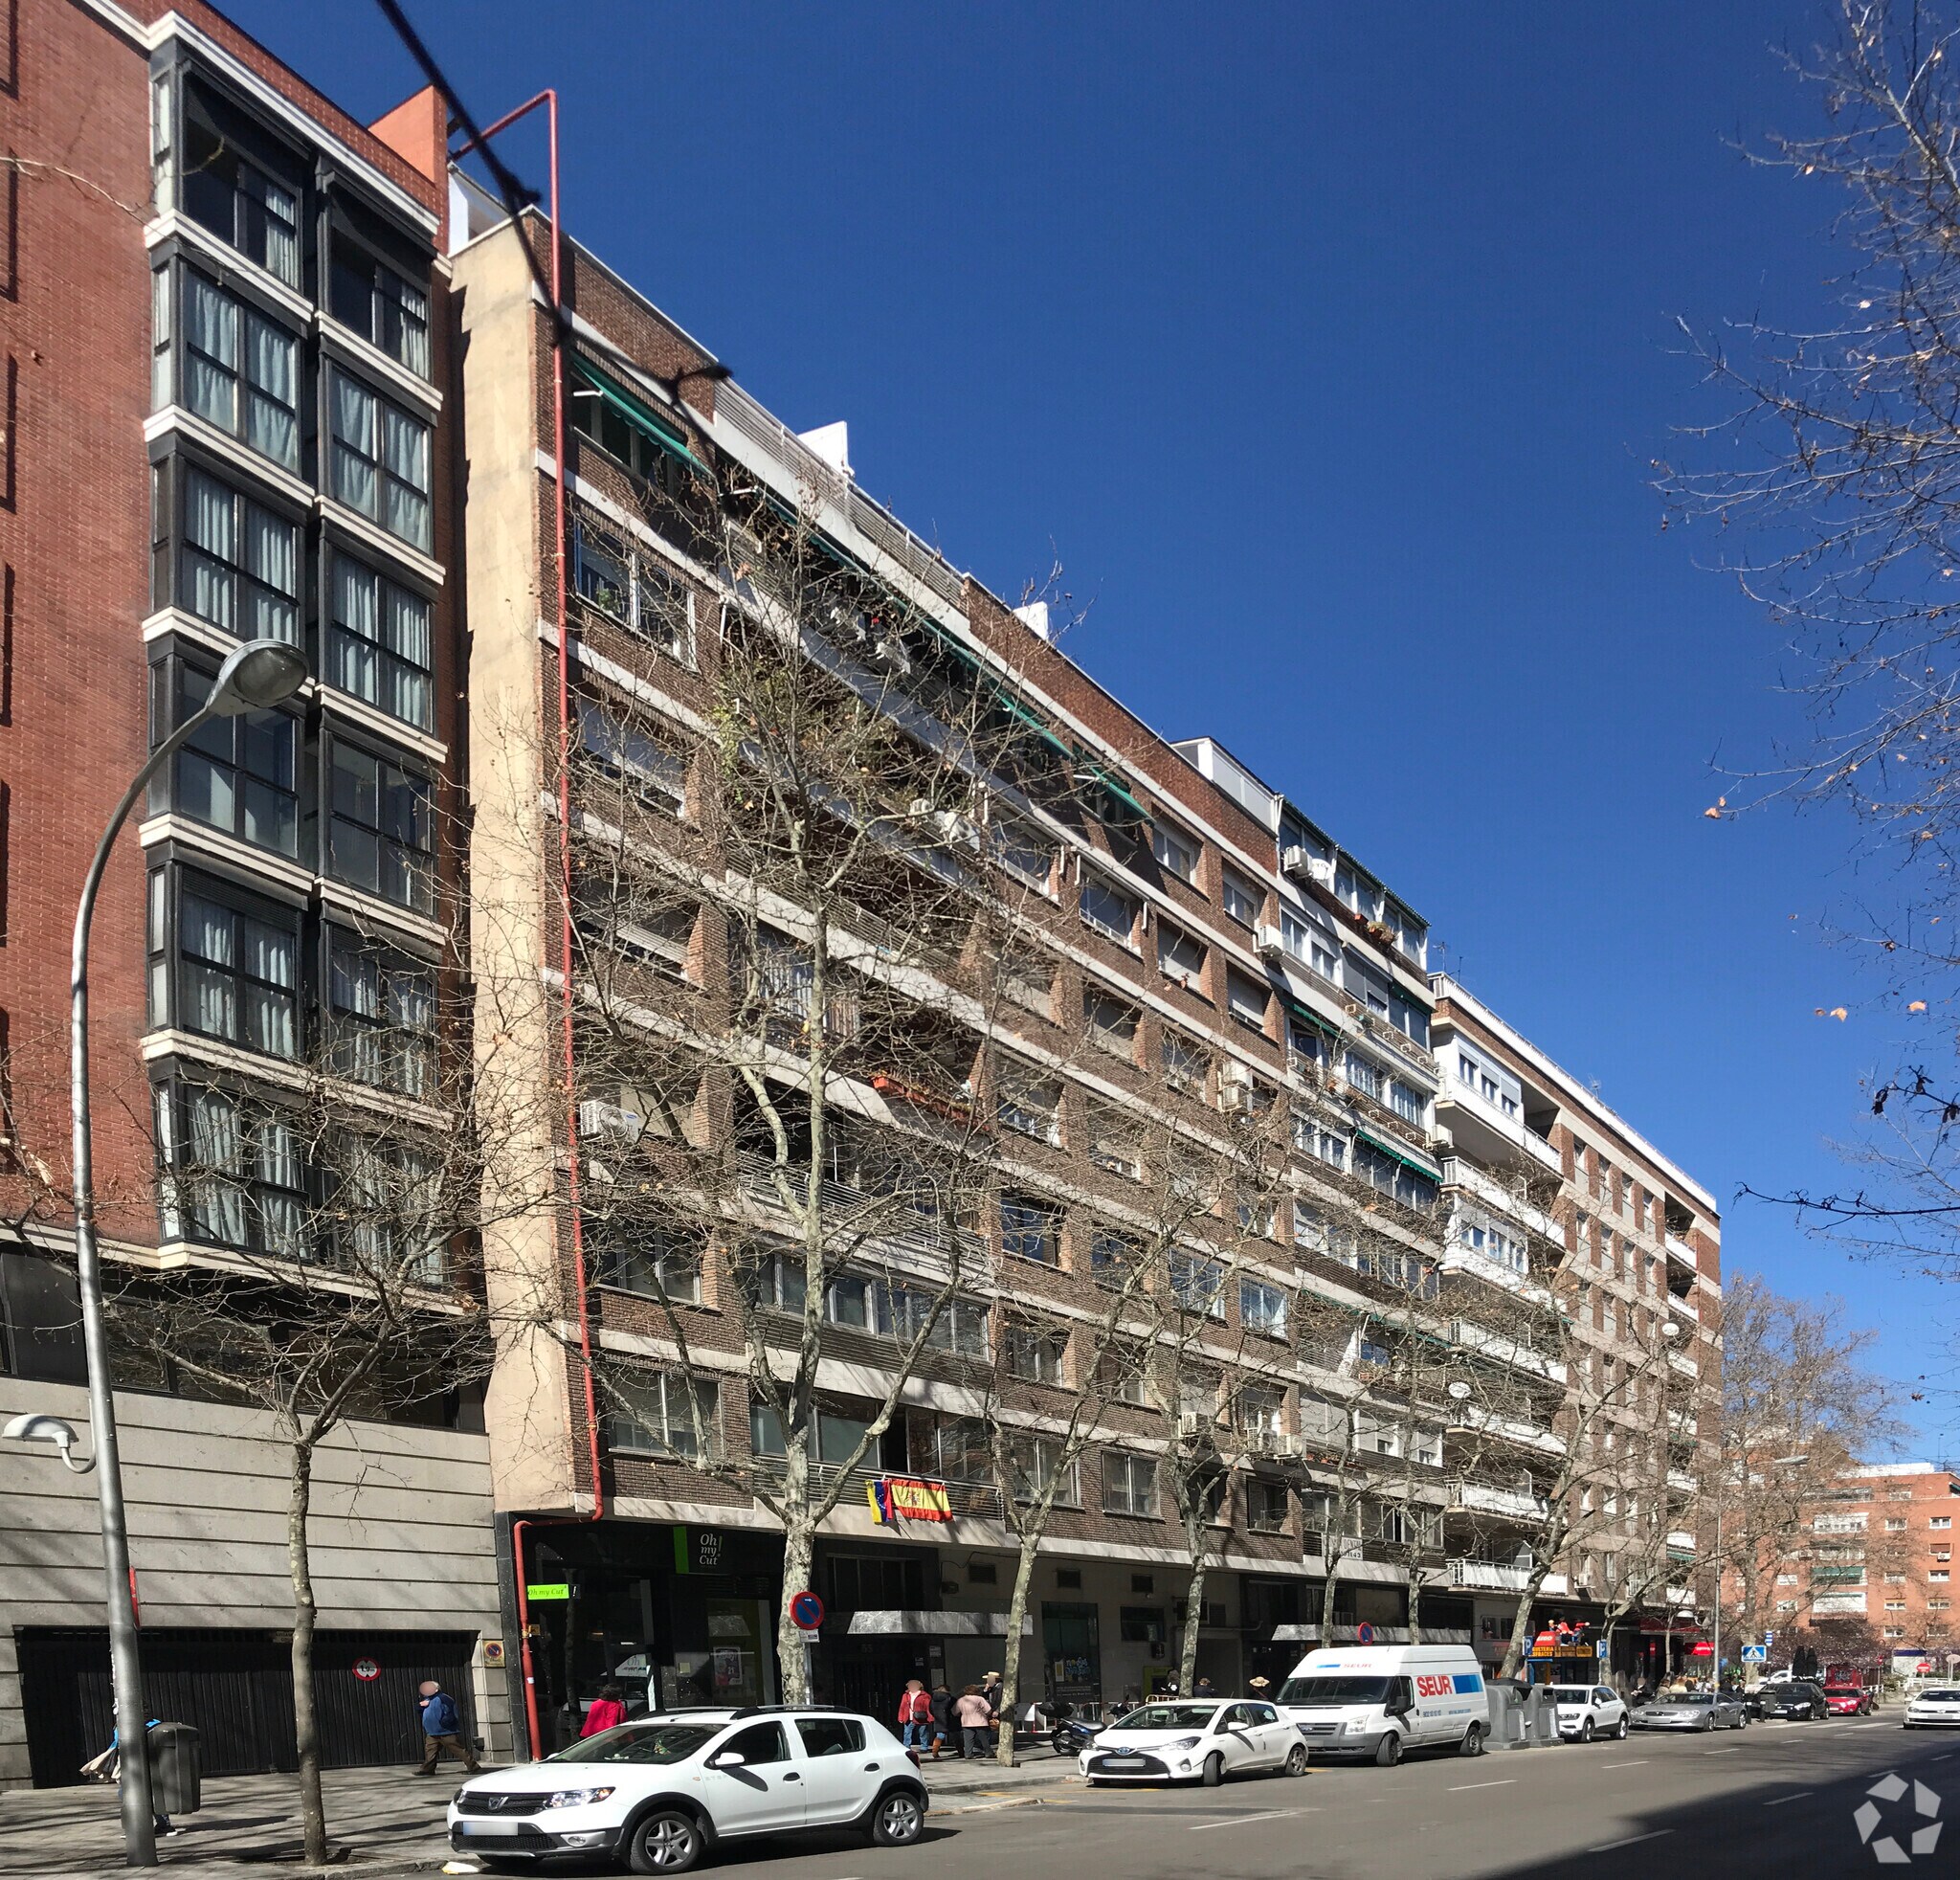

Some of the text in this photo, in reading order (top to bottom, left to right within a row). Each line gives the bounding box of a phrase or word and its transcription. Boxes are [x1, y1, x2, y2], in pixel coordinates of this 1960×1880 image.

[700, 1533, 718, 1546] Oh
[701, 1546, 718, 1556] my
[699, 1555, 718, 1565] Cut
[1417, 1675, 1452, 1697] SEUR
